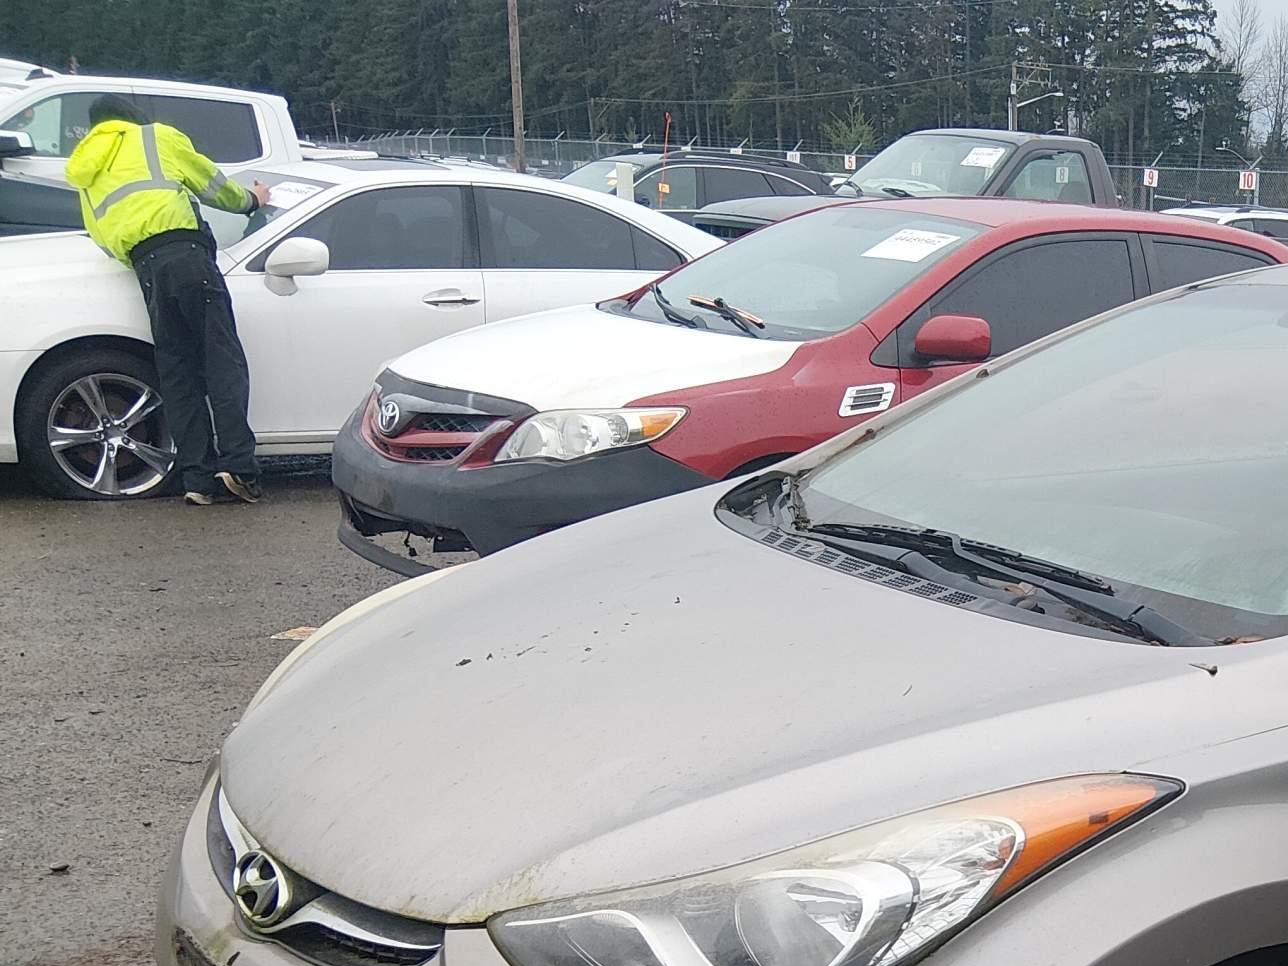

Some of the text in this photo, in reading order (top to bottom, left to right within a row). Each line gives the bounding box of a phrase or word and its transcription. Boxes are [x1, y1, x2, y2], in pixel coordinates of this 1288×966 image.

[847, 157, 853, 169] 5
[1148, 171, 1154, 185] 9
[1243, 173, 1254, 187] 10
